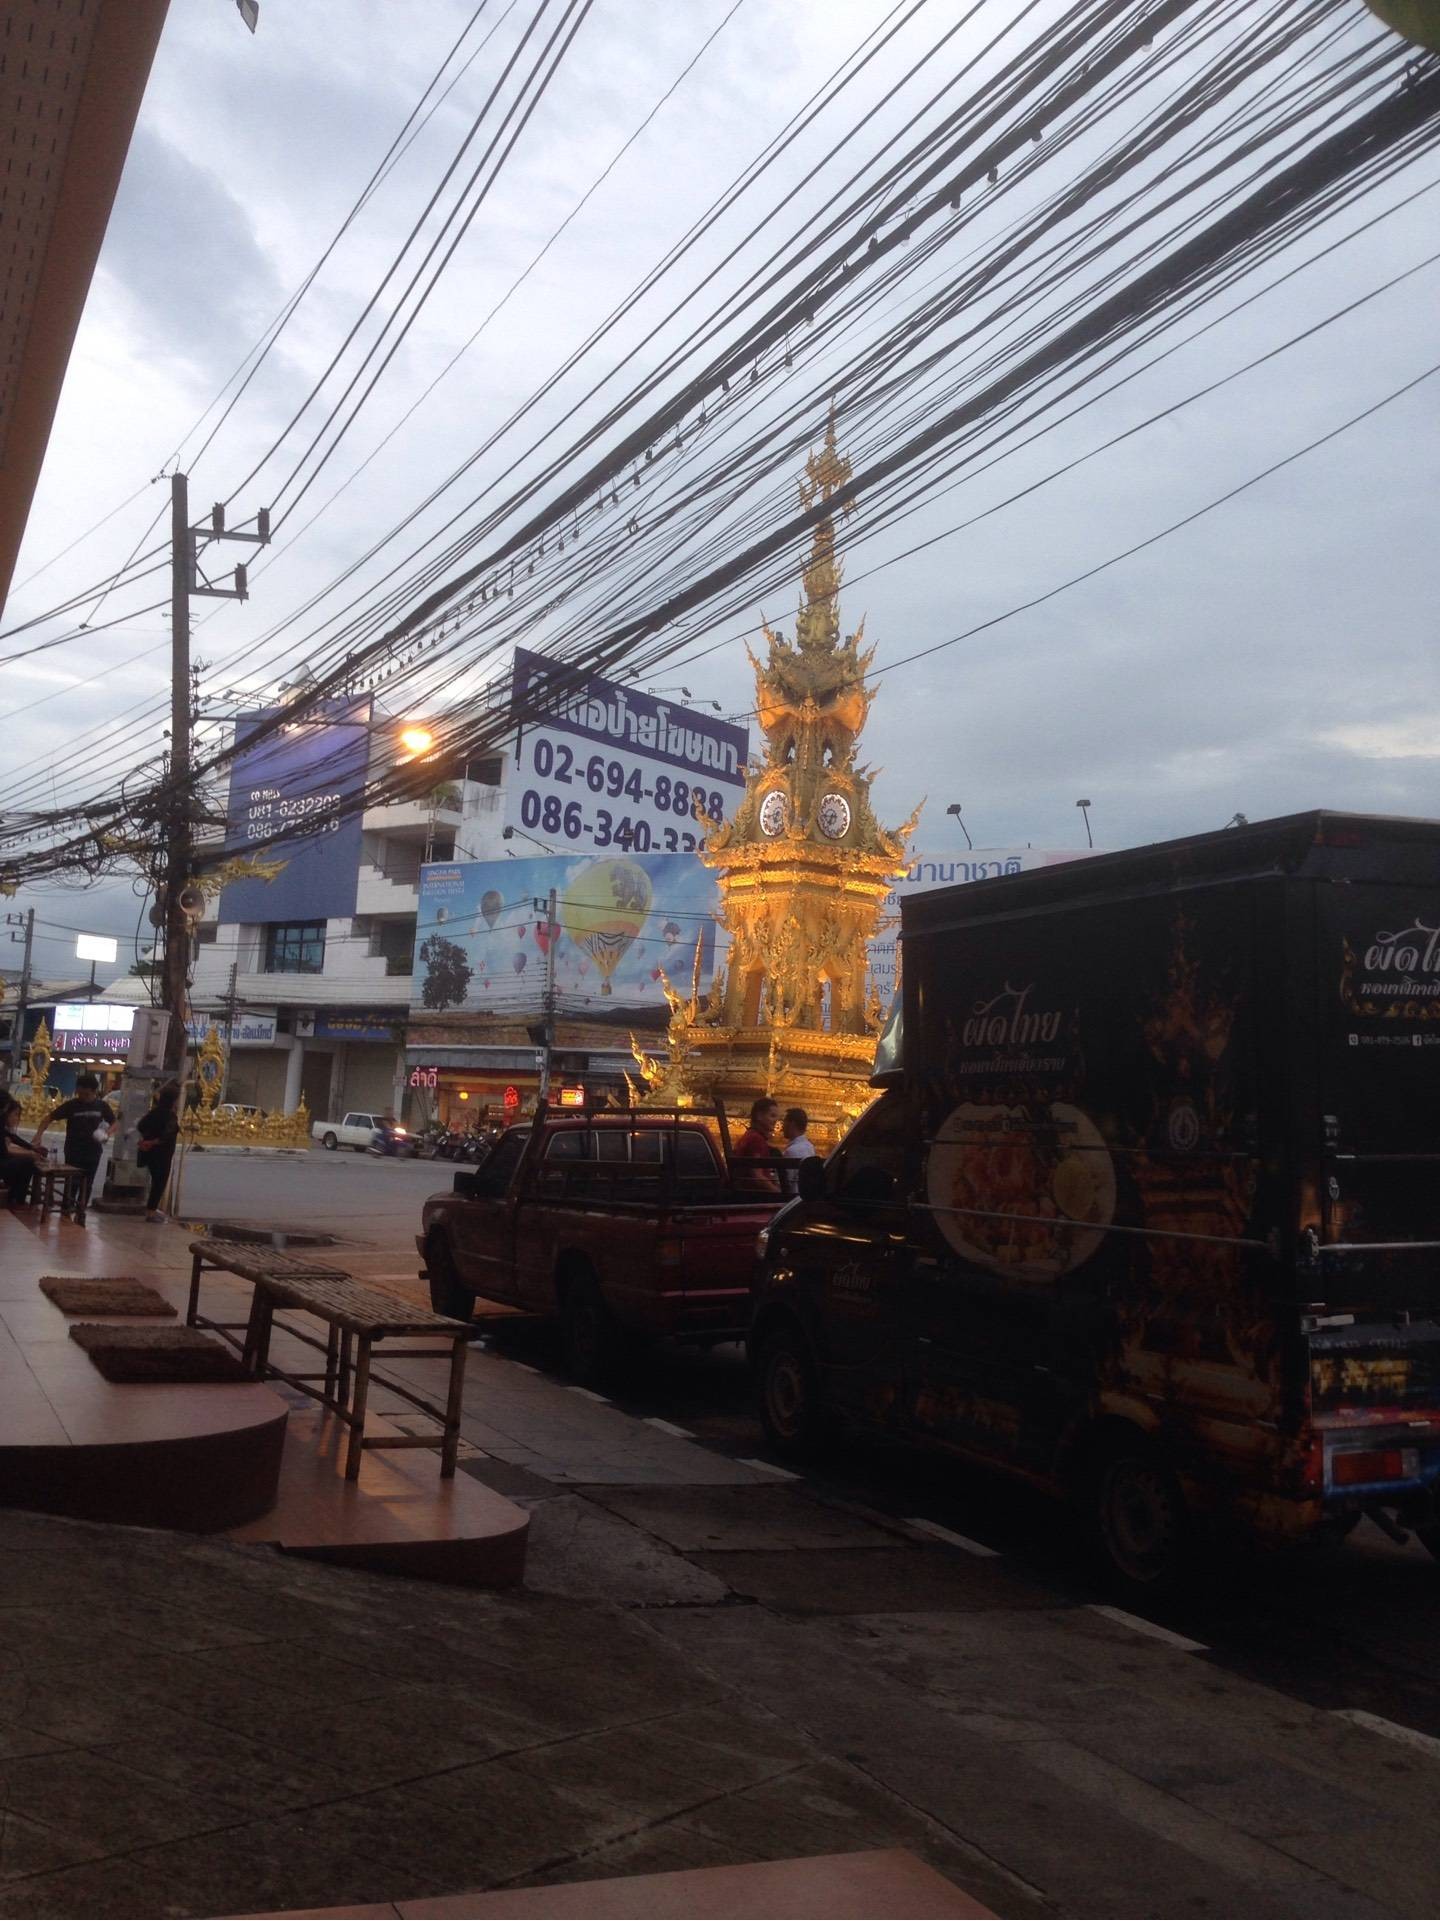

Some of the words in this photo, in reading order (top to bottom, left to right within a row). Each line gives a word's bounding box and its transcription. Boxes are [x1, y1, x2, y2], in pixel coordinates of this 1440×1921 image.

[533, 738, 724, 825] 02-694-8888
[521, 789, 706, 853] 086-340-33
[889, 856, 1022, 882] นานาชาติ
[1364, 917, 1440, 973] ผัดไ
[963, 981, 1062, 1046] ผัดไทย
